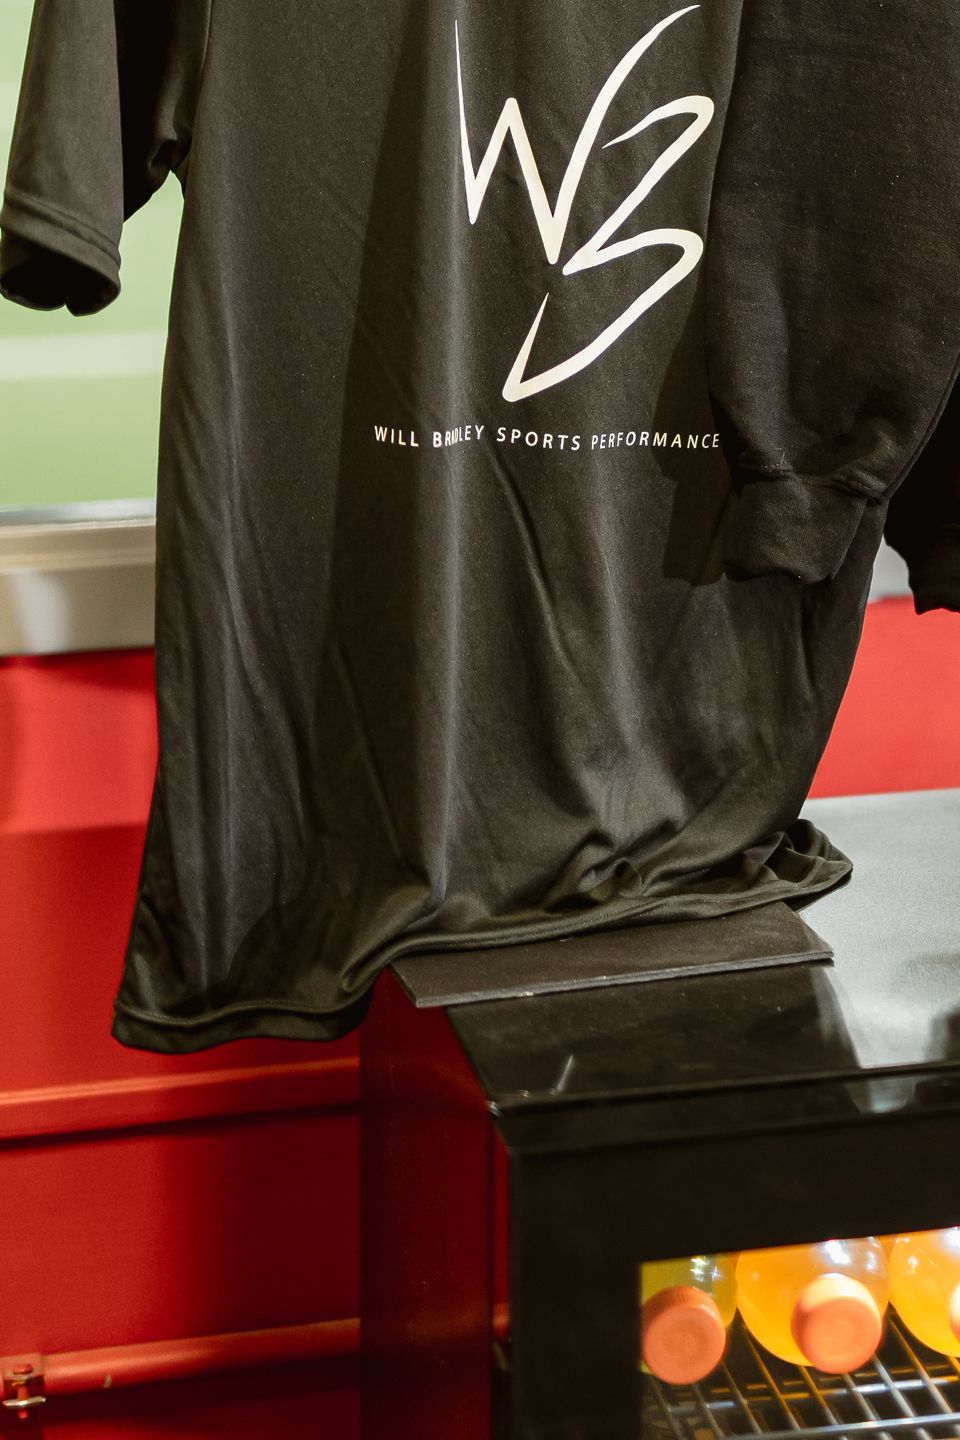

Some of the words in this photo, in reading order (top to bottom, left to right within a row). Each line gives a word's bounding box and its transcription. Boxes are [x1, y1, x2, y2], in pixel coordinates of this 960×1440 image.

[374, 425, 419, 448] WILL
[496, 426, 581, 451] SPORTS
[591, 430, 720, 450] PERFORMANCE
